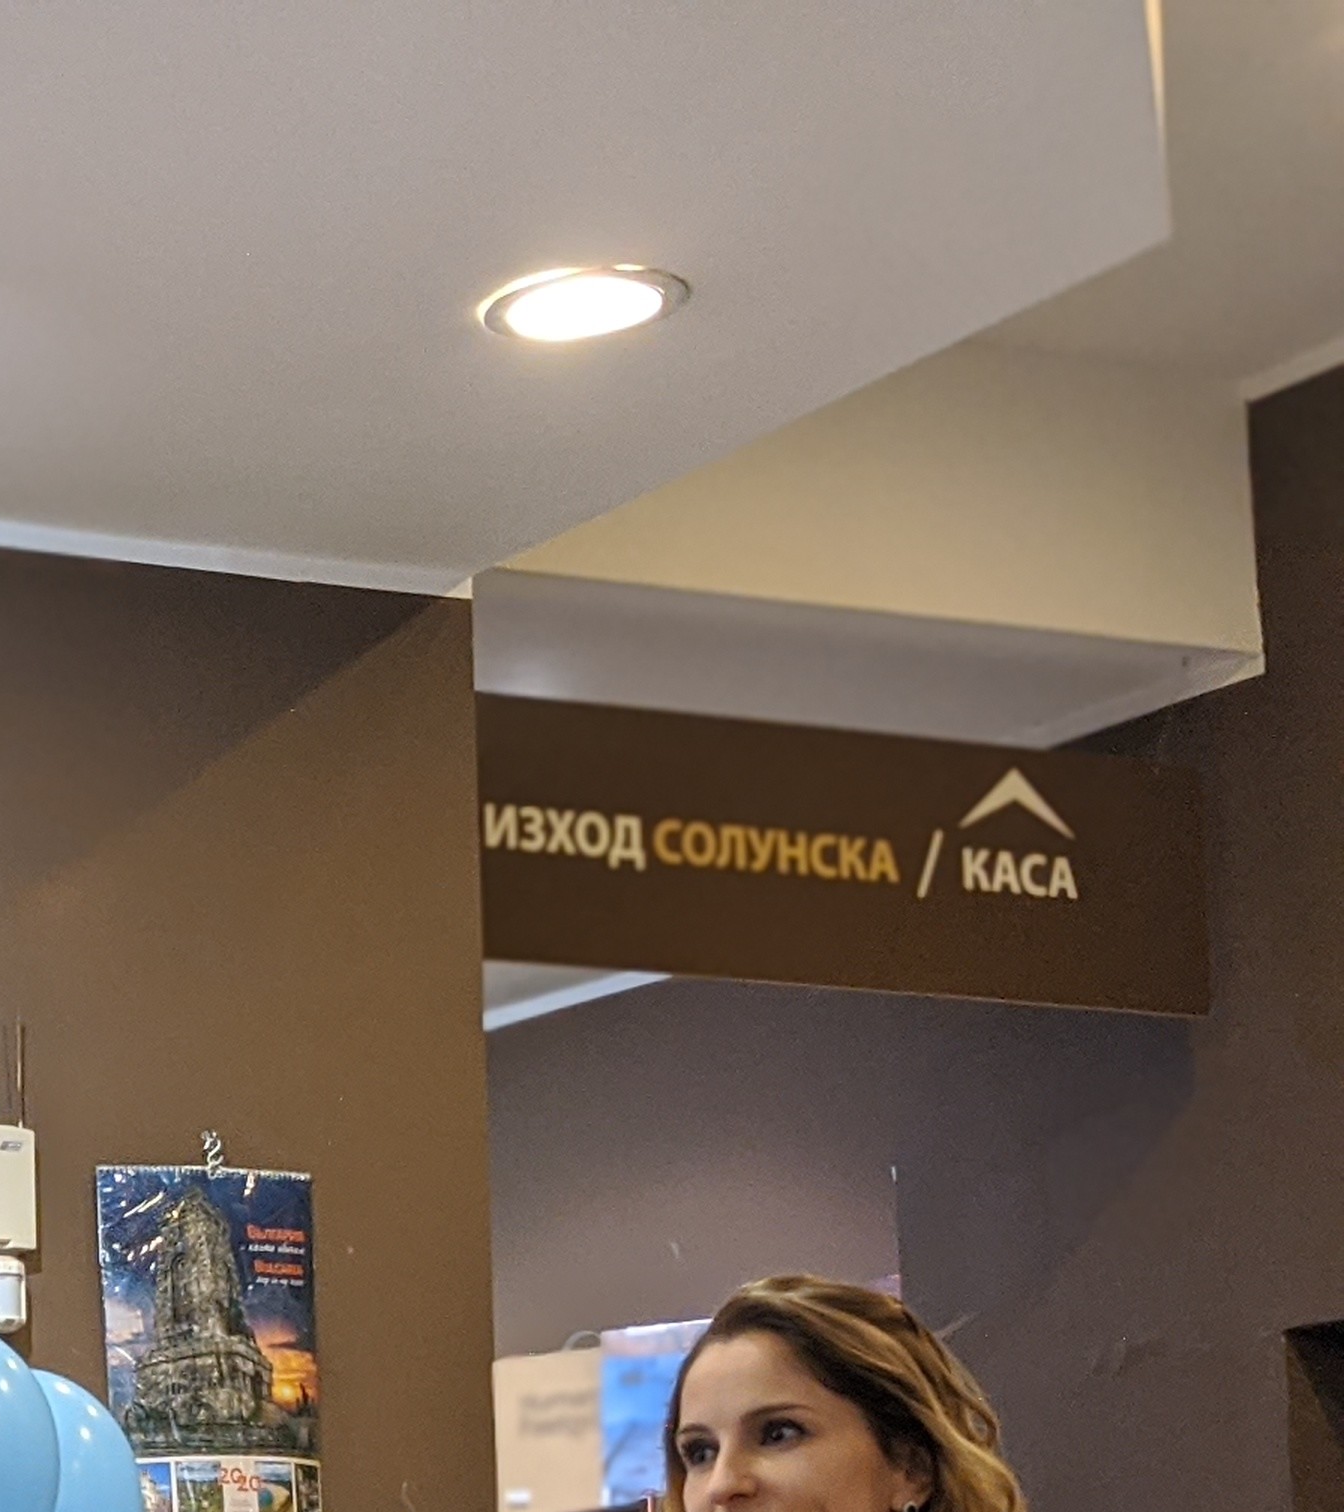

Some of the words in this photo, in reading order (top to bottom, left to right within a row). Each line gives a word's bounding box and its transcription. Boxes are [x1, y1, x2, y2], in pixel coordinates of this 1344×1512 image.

[483, 803, 646, 871] ИЗХОД
[653, 818, 900, 883] СОЛУНСКА
[961, 847, 1078, 899] КАСА
